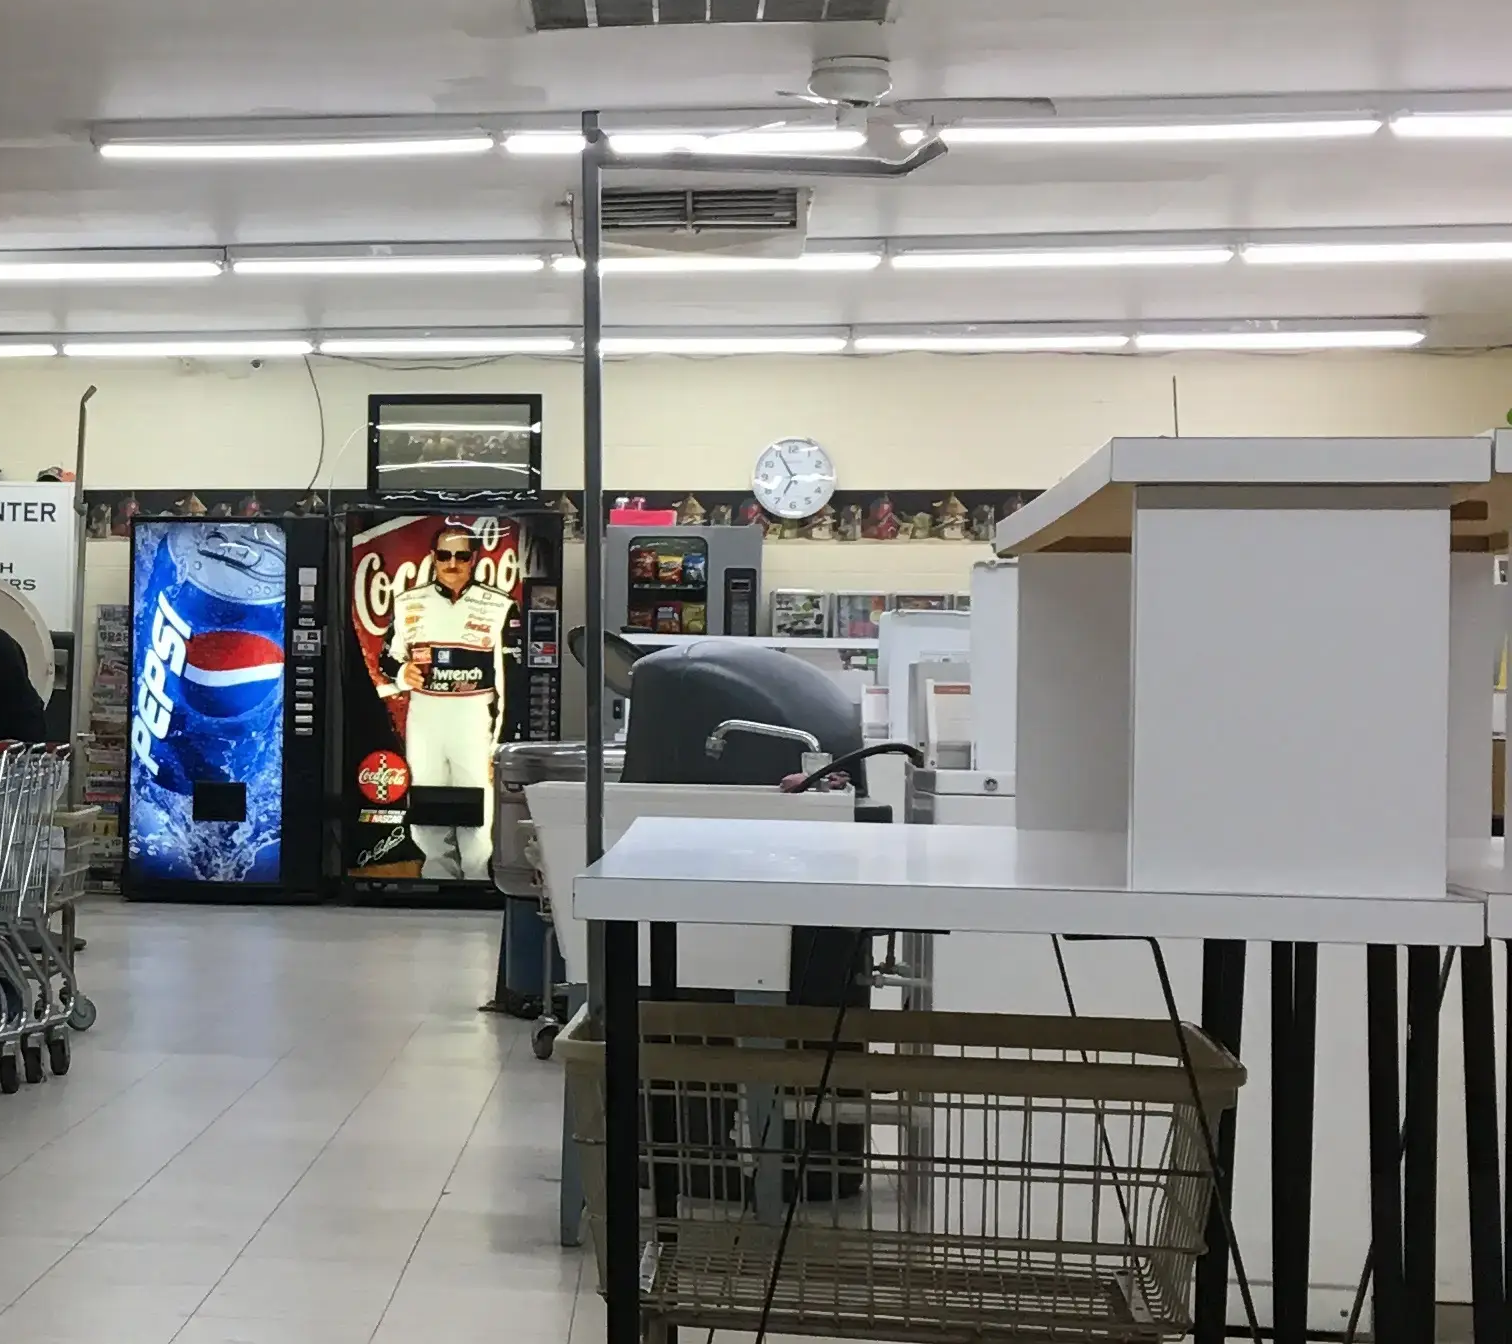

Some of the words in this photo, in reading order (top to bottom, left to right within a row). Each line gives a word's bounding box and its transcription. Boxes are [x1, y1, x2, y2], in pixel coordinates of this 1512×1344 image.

[788, 445, 799, 454] 12
[765, 460, 774, 468] 10
[814, 460, 822, 468] 2
[814, 486, 821, 494] 4
[774, 496, 781, 505] 7
[804, 497, 812, 505] 5
[789, 501, 797, 509] 6
[3, 578, 37, 592] RS
[131, 591, 192, 776] PEPSI
